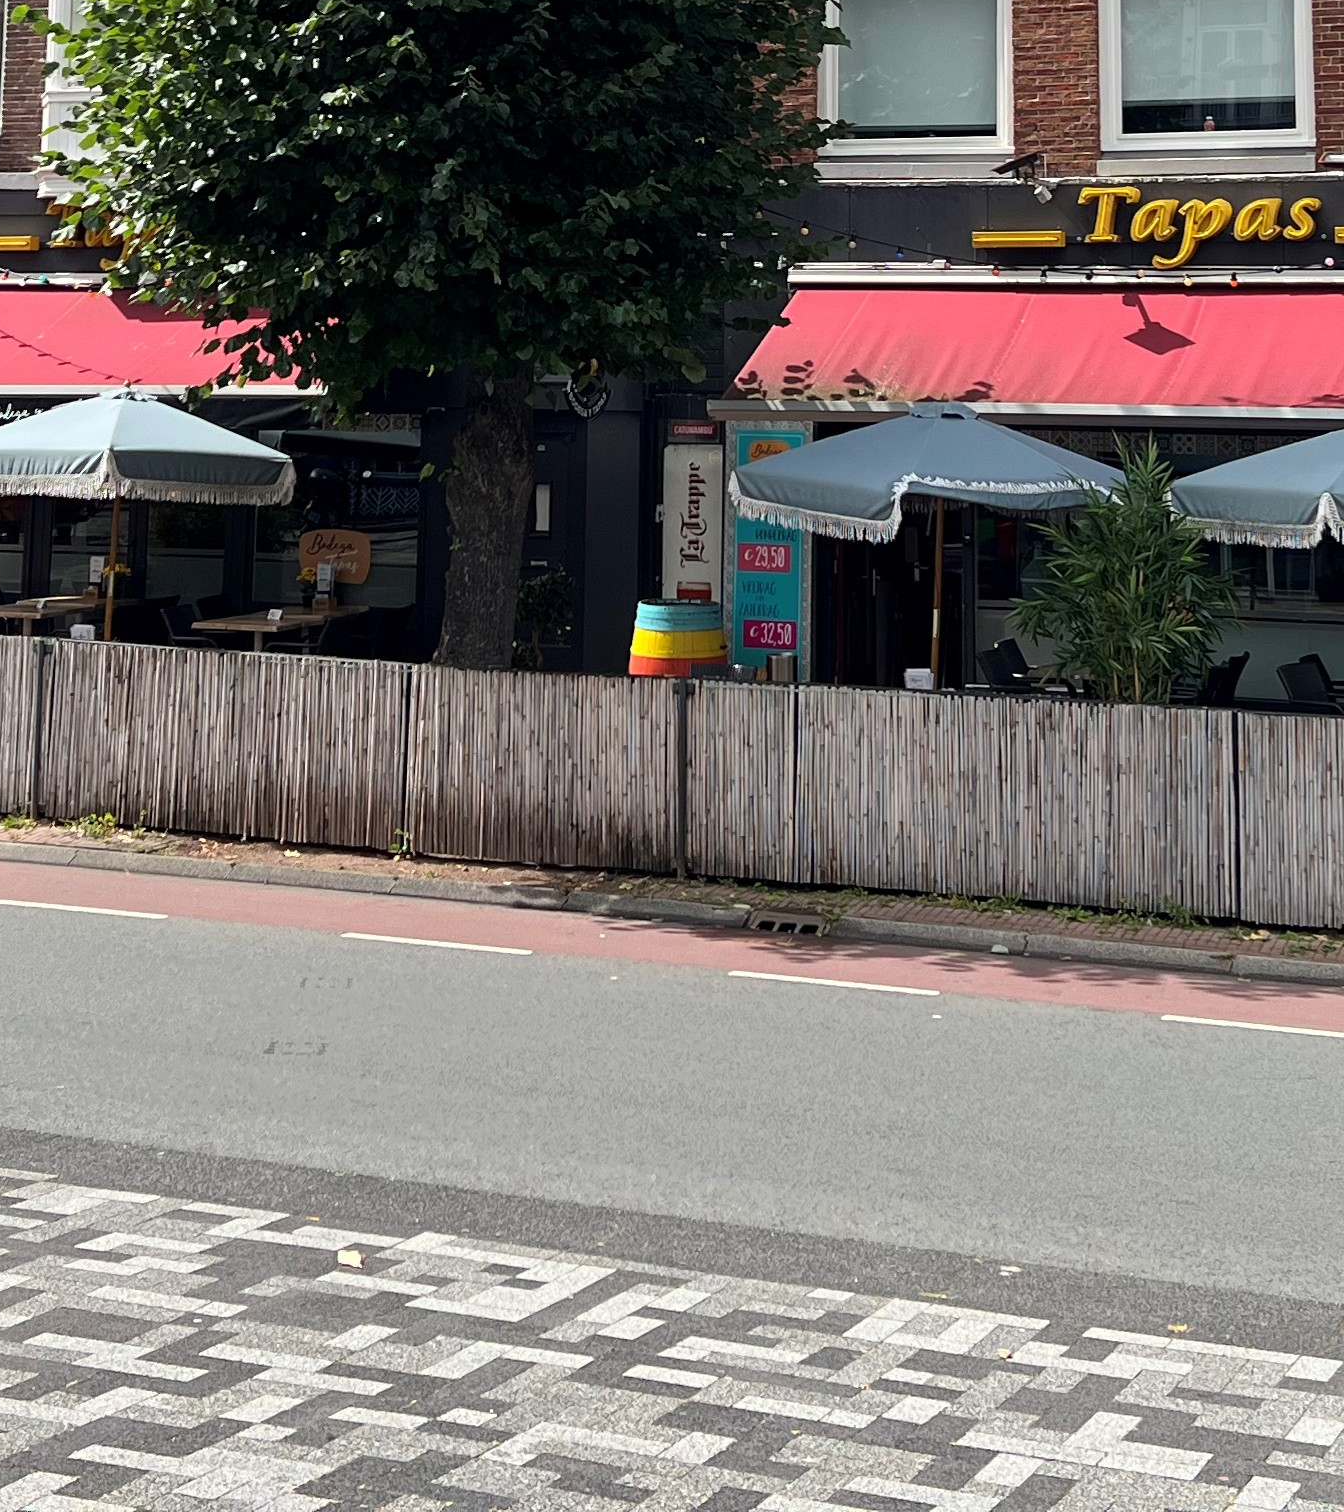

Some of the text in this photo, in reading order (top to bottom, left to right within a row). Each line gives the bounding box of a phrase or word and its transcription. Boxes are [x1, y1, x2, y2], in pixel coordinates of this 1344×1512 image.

[1077, 186, 1322, 269] Tapas
[679, 460, 709, 568] La Trappe
[306, 533, 356, 559] Bodega
[760, 622, 792, 646] 32,50
